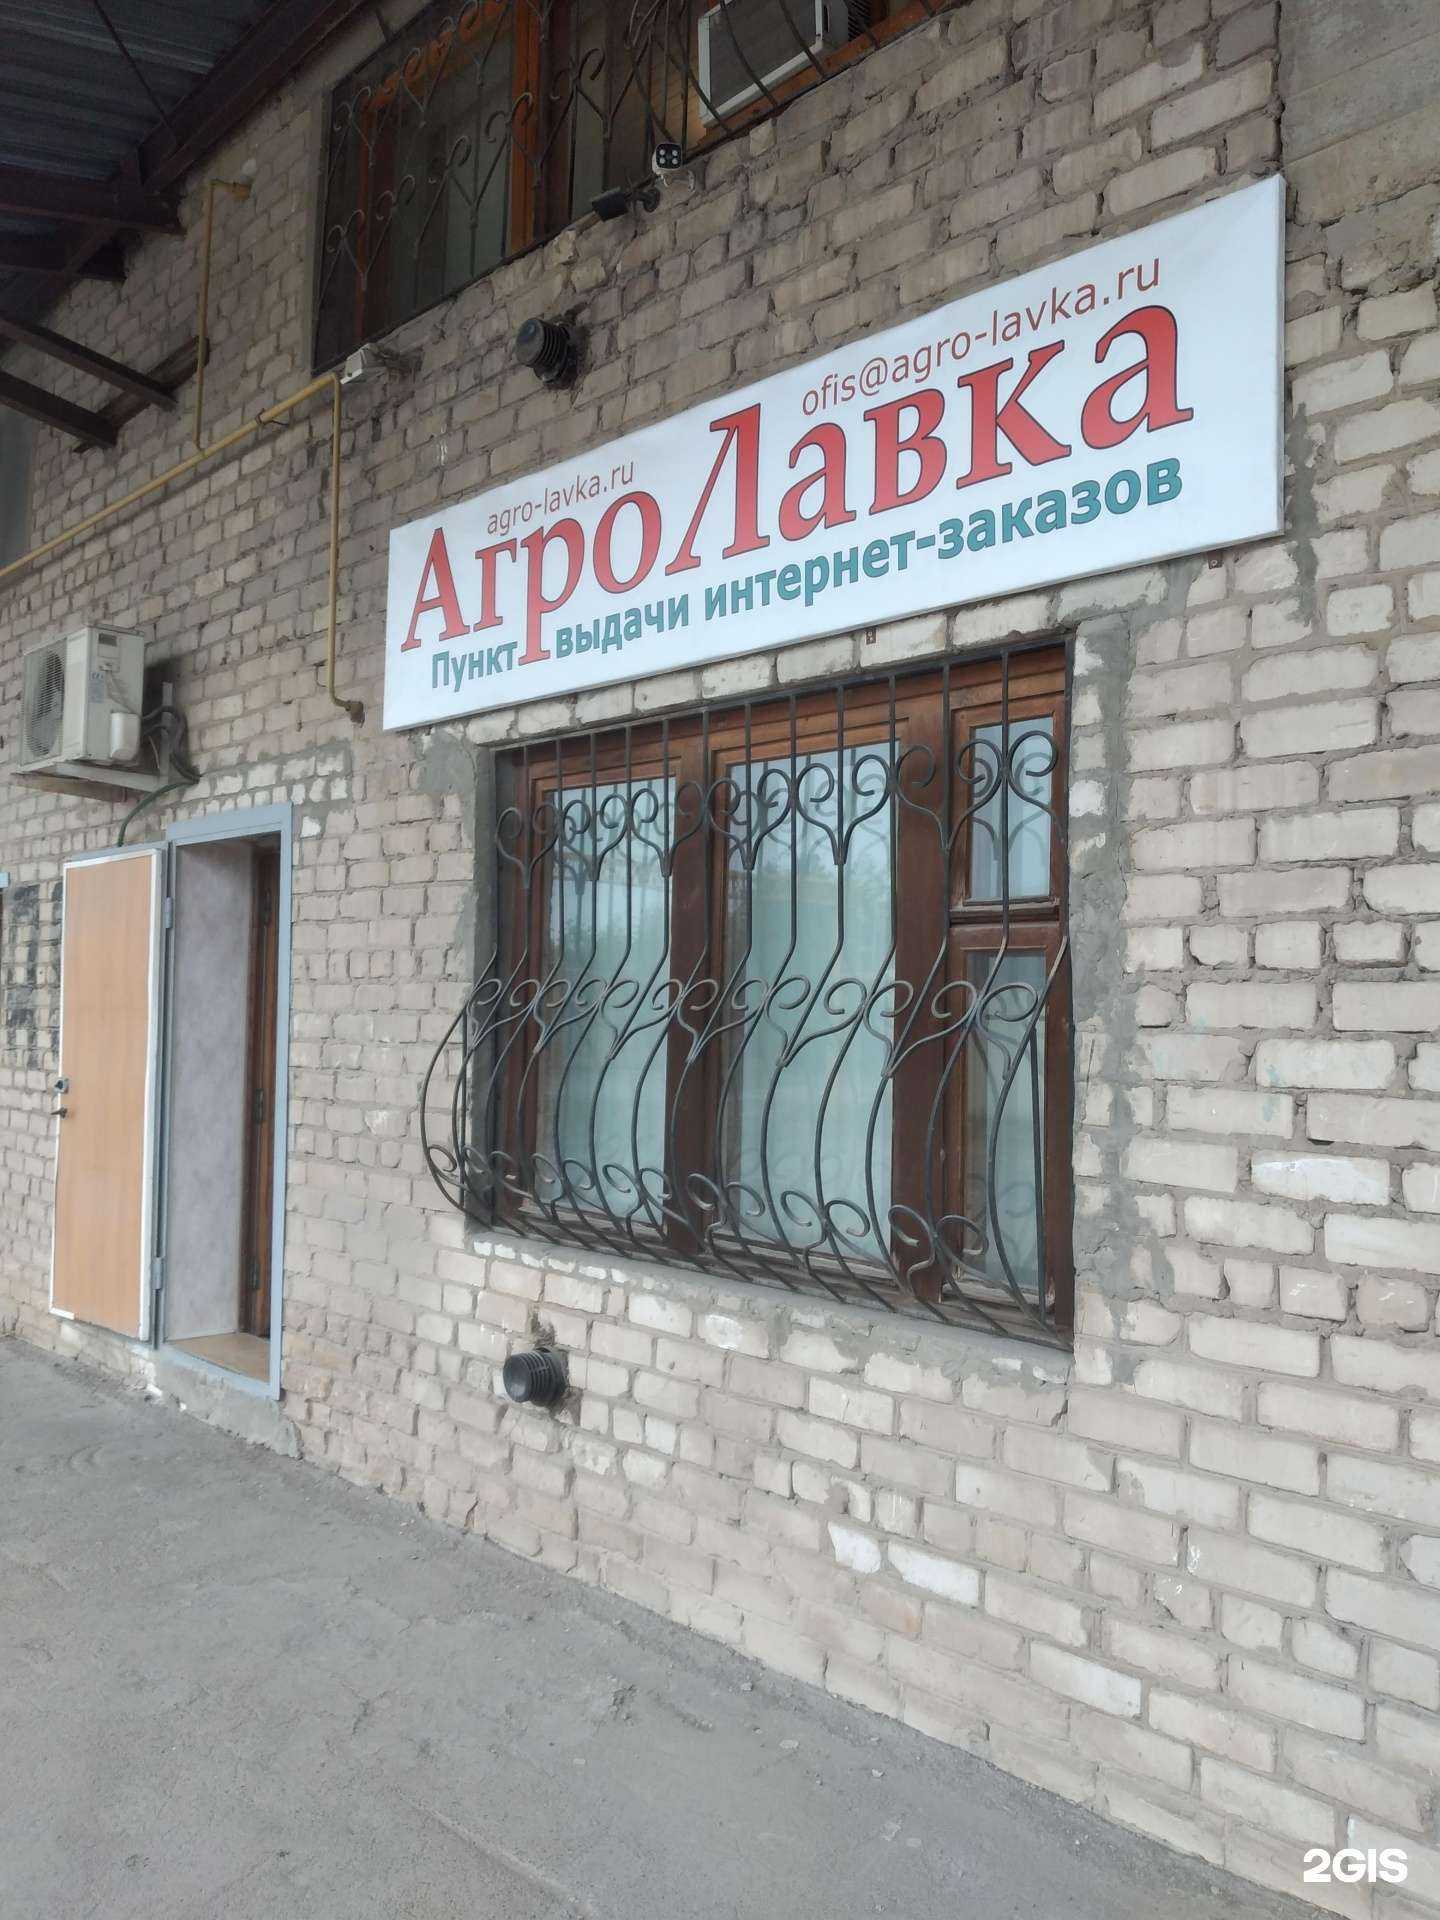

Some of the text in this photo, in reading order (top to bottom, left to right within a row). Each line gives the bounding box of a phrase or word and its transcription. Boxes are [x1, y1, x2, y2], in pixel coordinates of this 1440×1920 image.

[802, 258, 1160, 415] ofis@agro-lavka.ru
[400, 304, 1194, 666] АгроЛавка
[432, 457, 1183, 692] Пункт выдачи интернет-заказов
[487, 461, 635, 536] agro-lavka.ru
